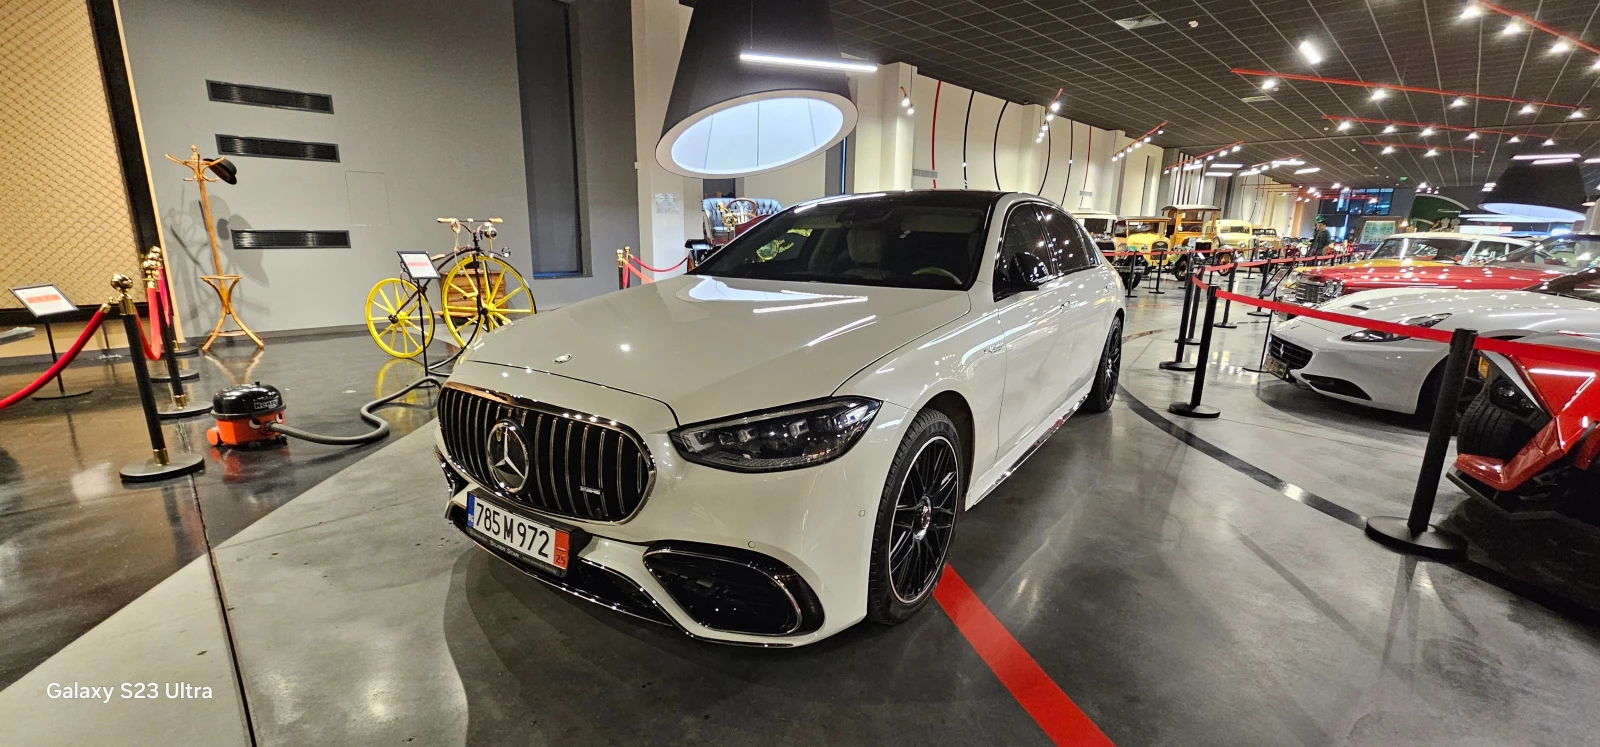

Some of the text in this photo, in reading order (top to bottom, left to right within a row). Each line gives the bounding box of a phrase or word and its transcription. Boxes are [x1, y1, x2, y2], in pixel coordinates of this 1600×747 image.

[476, 503, 550, 558] 785 M 972
[555, 554, 566, 565] 25
